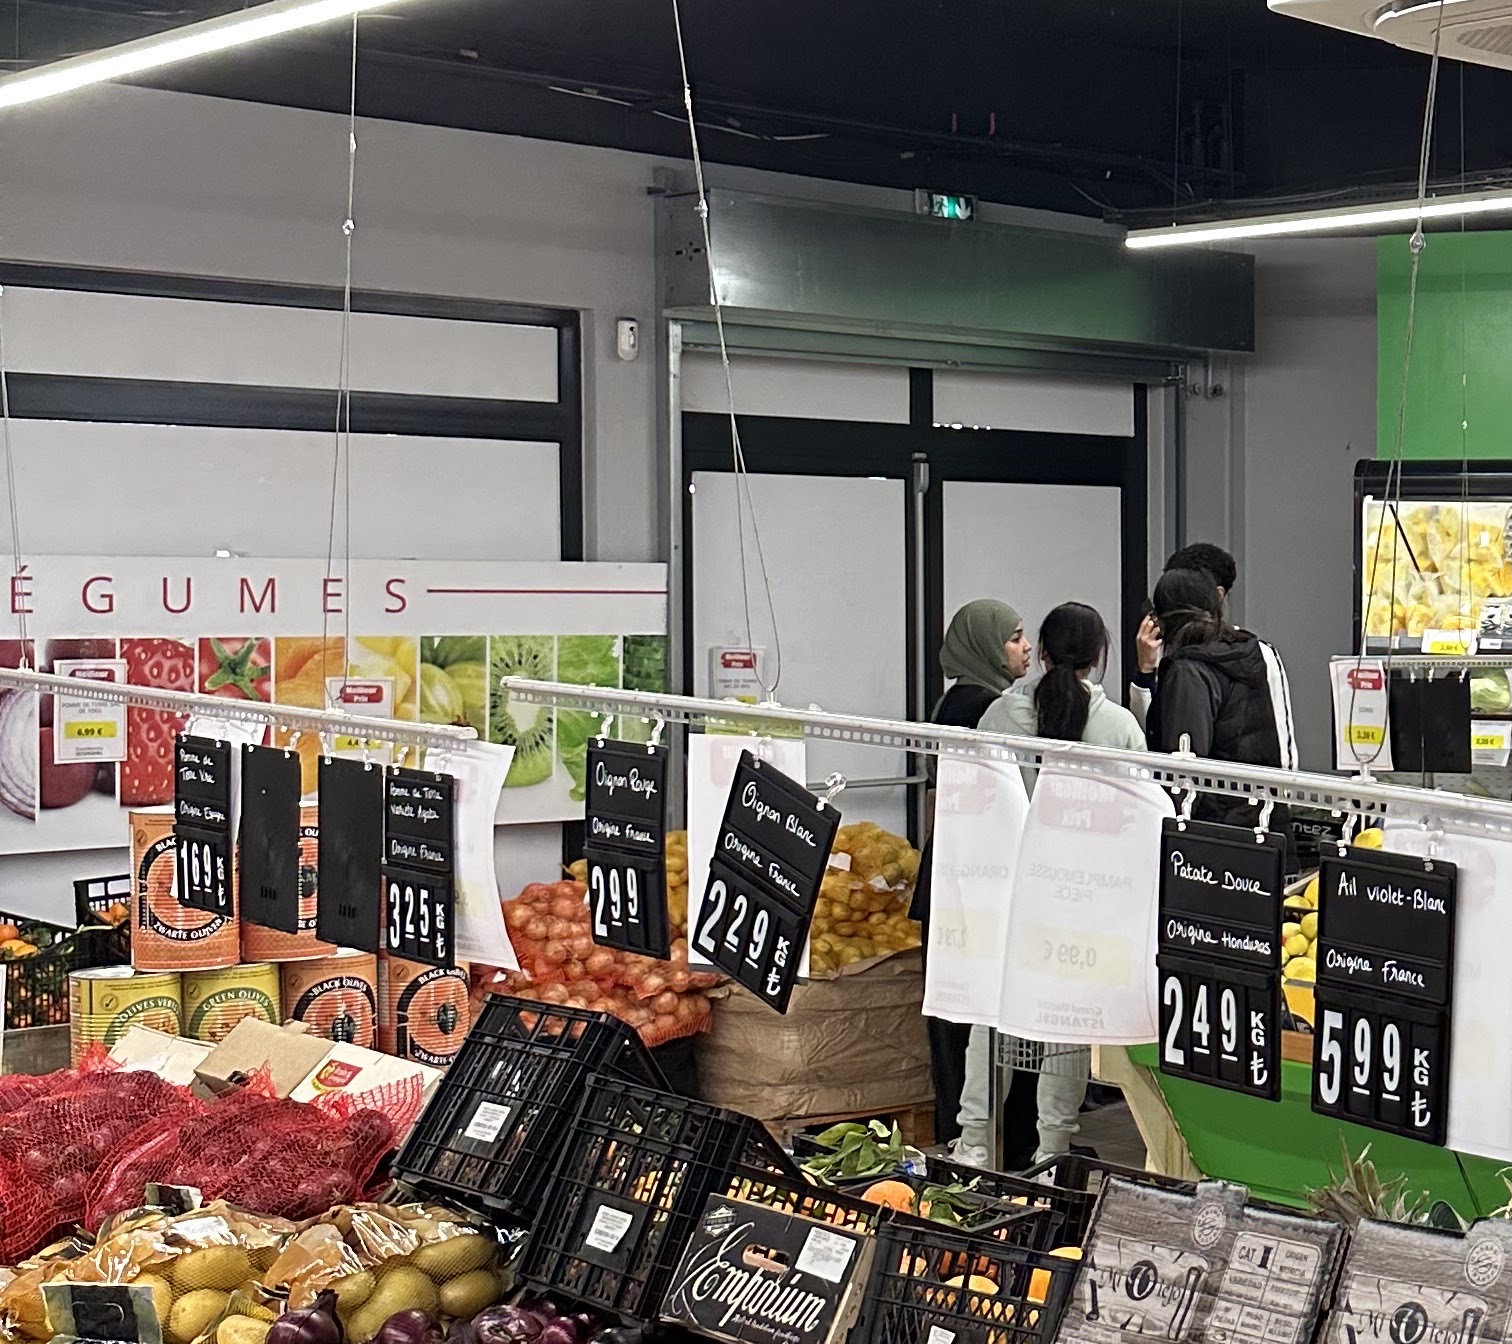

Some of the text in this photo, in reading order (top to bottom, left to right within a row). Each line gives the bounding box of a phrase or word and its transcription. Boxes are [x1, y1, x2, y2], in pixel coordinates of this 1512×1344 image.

[595, 760, 629, 796] Oignon
[592, 816, 622, 839] Origine
[741, 781, 817, 848] Oignon Blanc
[1293, 816, 1333, 838] ntez
[155, 836, 176, 853] BLAC
[216, 856, 224, 880] KG
[724, 831, 801, 898] Origine France
[1171, 850, 1272, 897] Patate Douce
[591, 865, 640, 938] 299
[1337, 871, 1358, 897] Ail
[389, 882, 430, 949] 325
[435, 903, 446, 930] KG
[698, 879, 770, 969] 229
[773, 935, 791, 967] KG
[1167, 919, 1273, 955] Origine Honduras
[418, 967, 445, 986] BLACK
[1326, 948, 1373, 974] Origine
[202, 989, 270, 1012] GREEN OLIVES
[311, 977, 340, 997] BLACK
[118, 997, 156, 1023] OLIVES
[1163, 976, 1239, 1067] 249
[1250, 1010, 1265, 1047] KG
[1319, 1009, 1401, 1105] 599
[1413, 1047, 1430, 1087] KG
[1238, 1245, 1257, 1262] CAT
[676, 1221, 826, 1333] Emporium
[1125, 1260, 1182, 1307] Viejo
